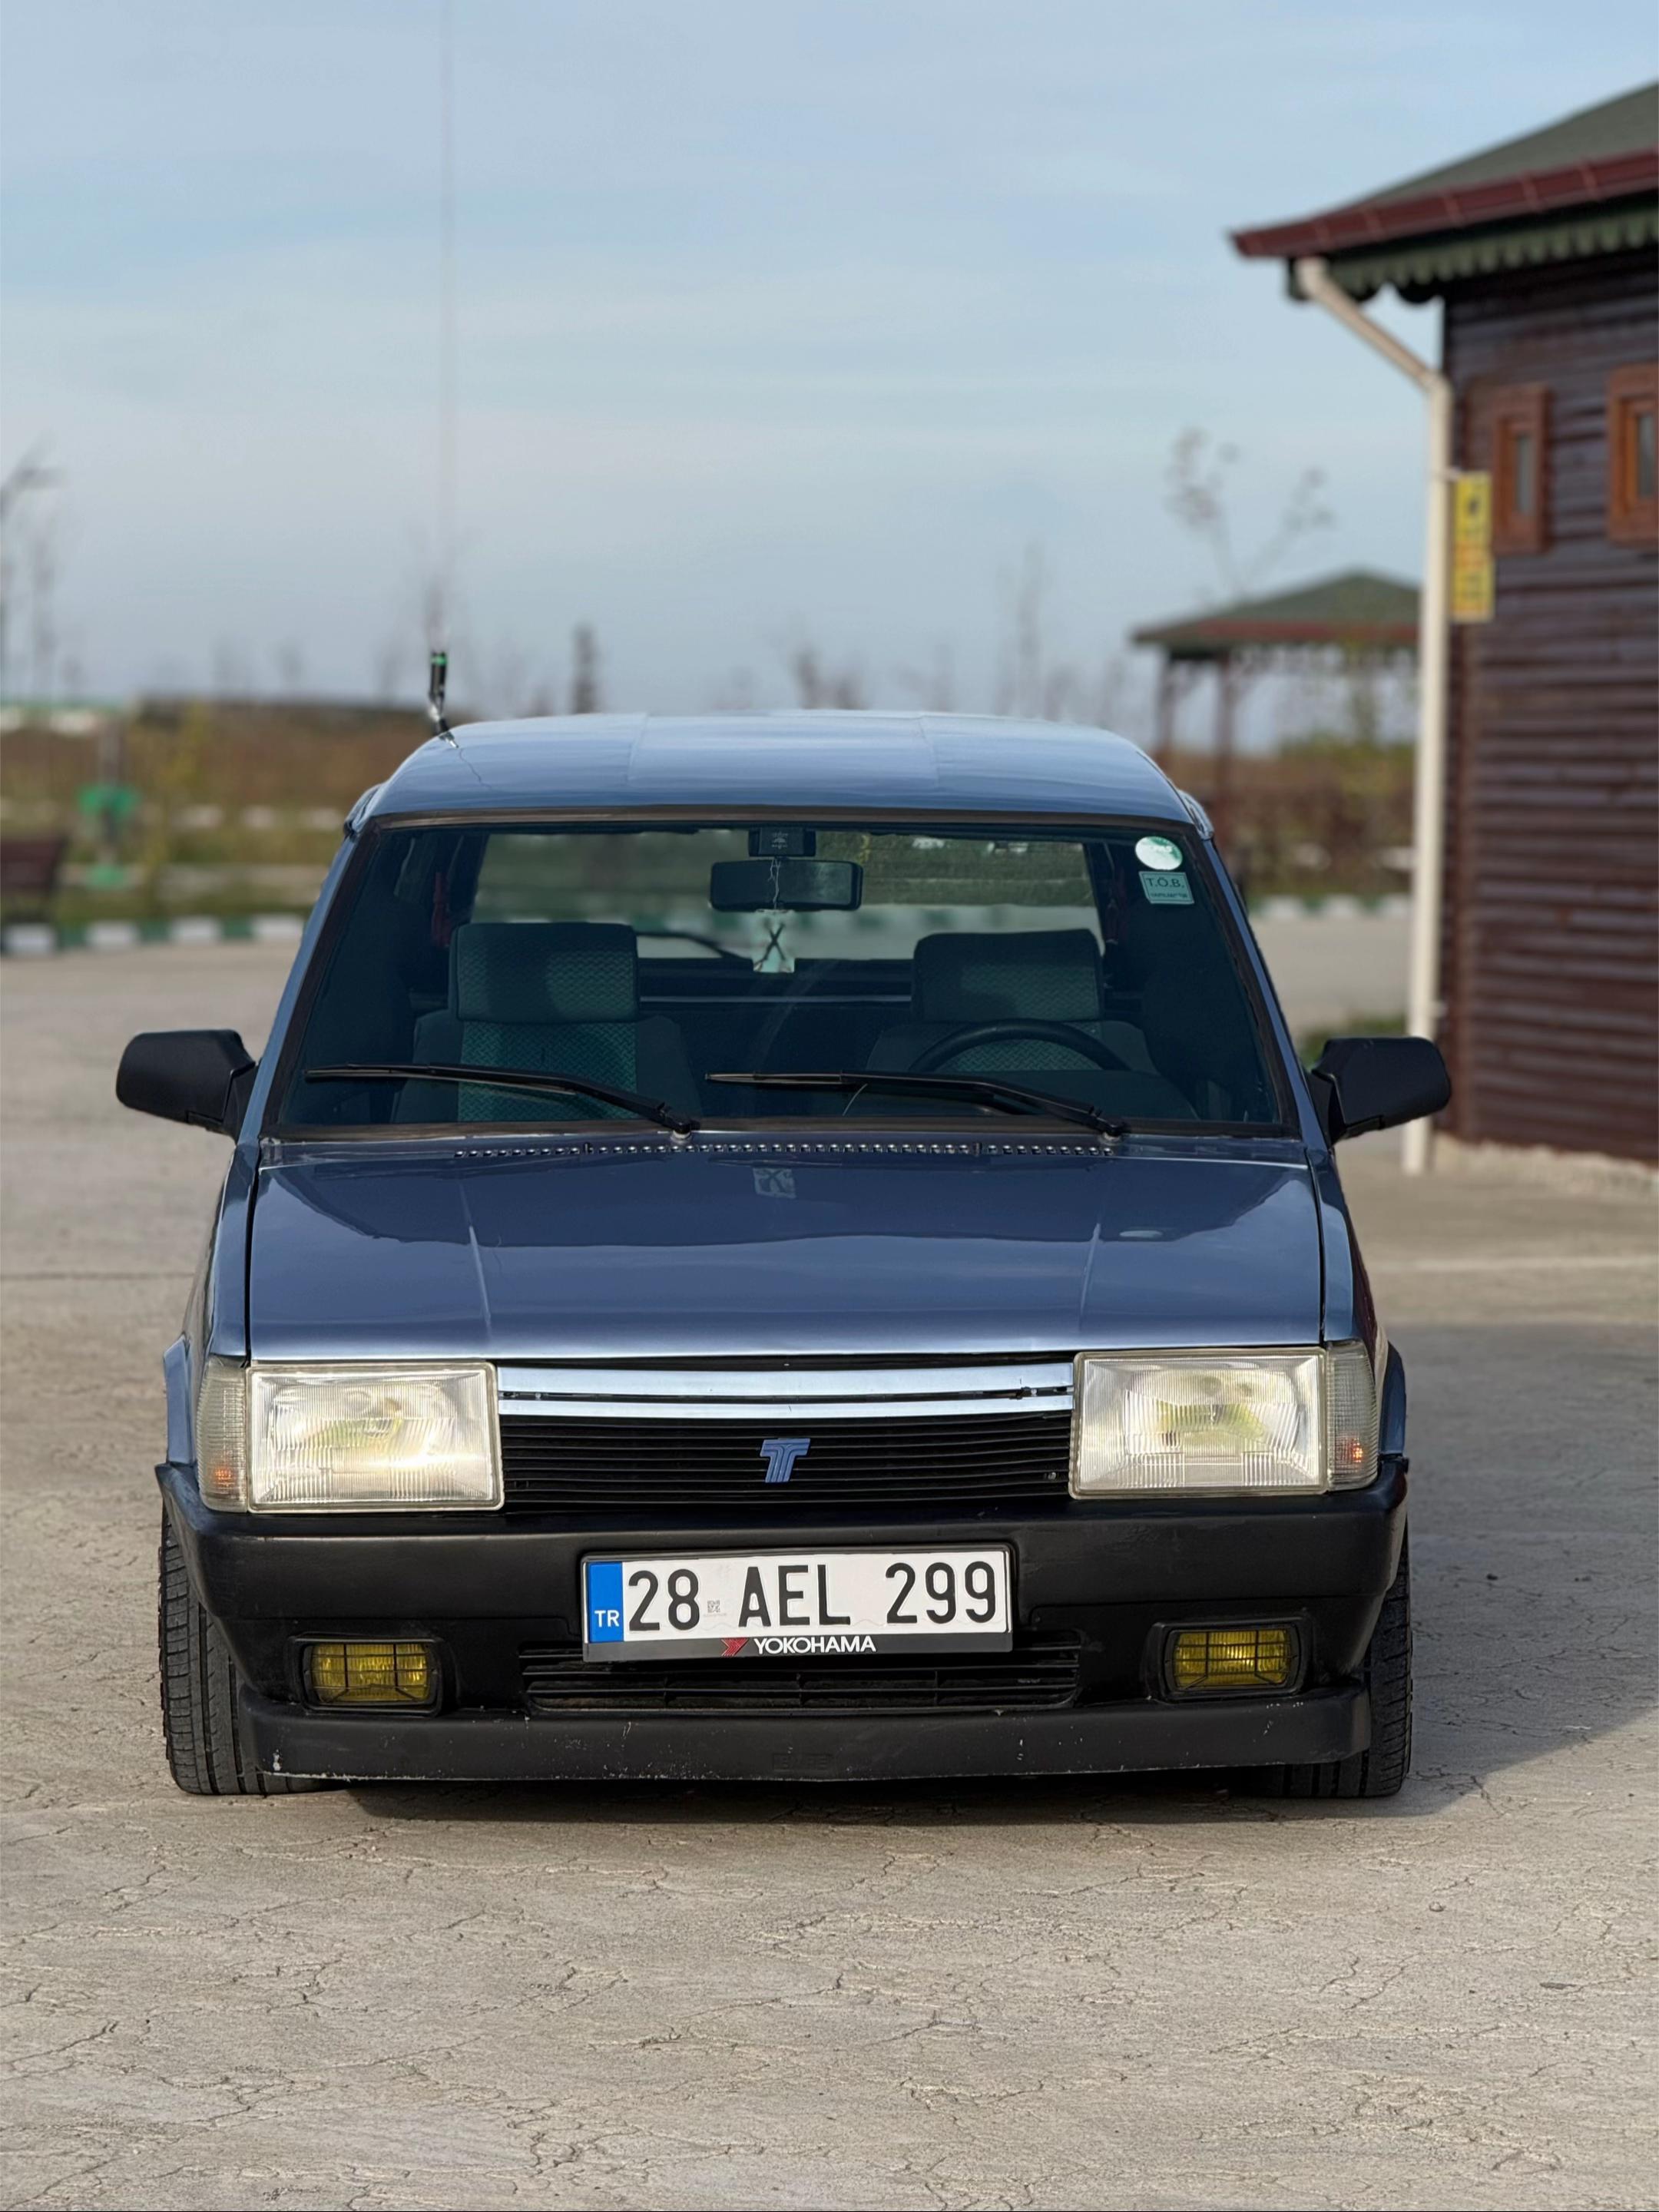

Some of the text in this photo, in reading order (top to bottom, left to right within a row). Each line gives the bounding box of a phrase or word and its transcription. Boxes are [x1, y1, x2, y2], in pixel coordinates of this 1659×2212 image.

[628, 1561, 996, 1631] 28 AEL 299
[595, 1610, 620, 1628] TR
[753, 1636, 876, 1654] YOKOHAMA
